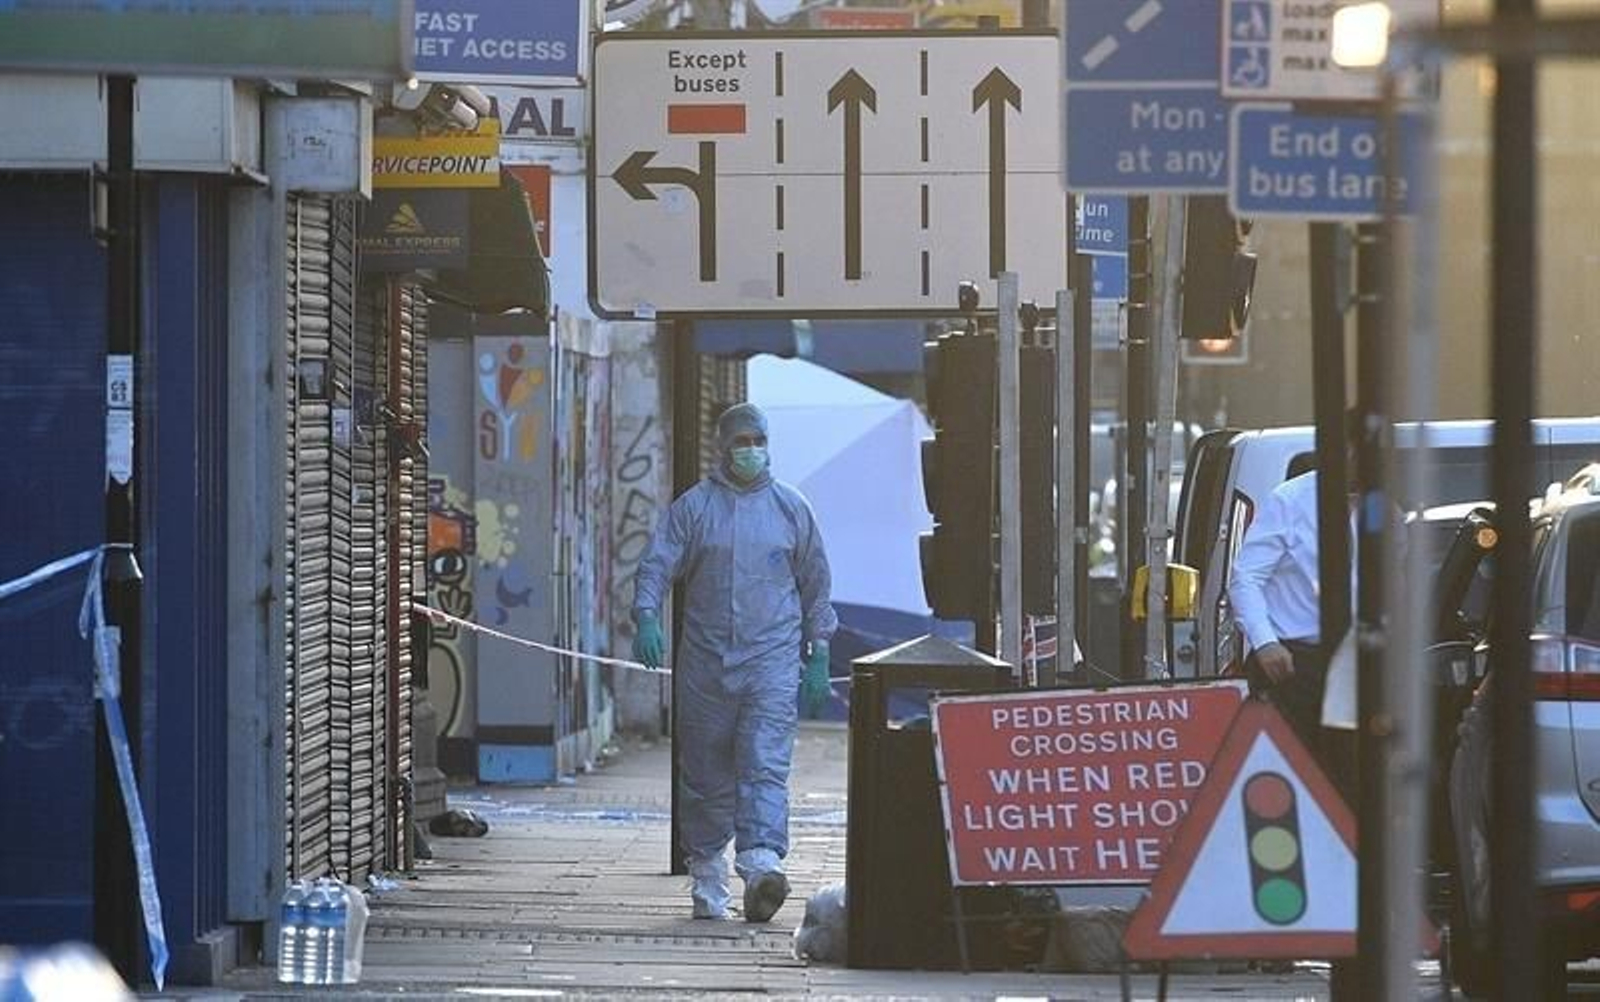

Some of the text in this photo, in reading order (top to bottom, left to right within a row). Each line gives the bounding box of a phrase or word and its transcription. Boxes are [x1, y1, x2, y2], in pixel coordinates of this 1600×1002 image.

[415, 12, 478, 32] FAST
[463, 39, 567, 61] ACCESS
[667, 50, 747, 70] Except
[673, 75, 741, 93] buses
[1131, 102, 1206, 129] Mon
[1268, 125, 1382, 158] End o
[1117, 147, 1225, 178] at any
[1250, 166, 1316, 198] bus
[1084, 202, 1108, 217] un
[992, 698, 1190, 730] PEDESTRIAN
[1010, 727, 1179, 757] CROSSING
[988, 760, 1206, 795] WHEN RED
[963, 798, 1189, 831] LIGHT SHO
[984, 846, 1080, 872] WAIT
